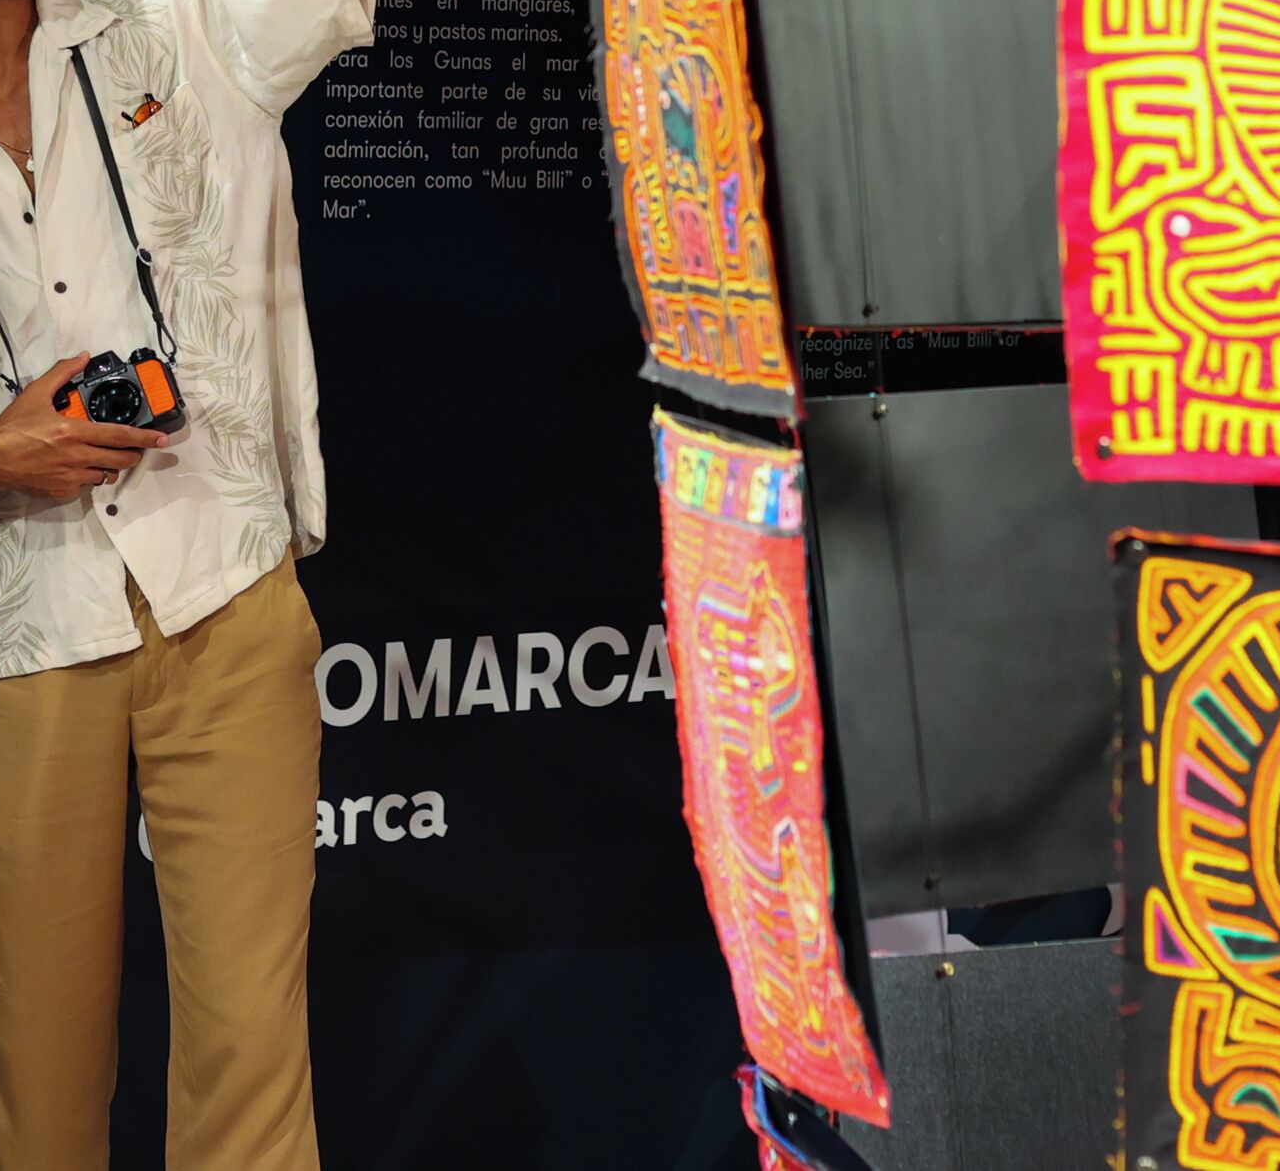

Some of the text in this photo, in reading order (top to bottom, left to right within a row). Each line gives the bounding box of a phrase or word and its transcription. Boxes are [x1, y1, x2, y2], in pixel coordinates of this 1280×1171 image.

[373, 23, 564, 43] inos y pastos marinos.
[389, 49, 414, 69] los
[433, 50, 493, 71] Gunas
[511, 52, 527, 70] el
[546, 58, 580, 72] mar
[325, 79, 424, 103] importante
[440, 84, 489, 104] parte
[504, 81, 527, 101] de
[542, 88, 562, 101] su
[324, 109, 604, 135] conexión familiar de gran res
[324, 139, 430, 162] admiración,
[451, 143, 480, 159] tan
[500, 141, 579, 164] profunda
[323, 173, 416, 190] reconocen
[424, 174, 473, 190] como
[482, 169, 527, 190] “Muu
[536, 170, 573, 190] Billi”
[581, 177, 593, 189] o
[800, 334, 873, 357] recognize
[880, 333, 890, 350] it
[896, 336, 915, 350] as
[1005, 334, 1021, 348] or
[800, 361, 829, 381] ther
[320, 623, 677, 730] OMARCA
[315, 789, 448, 849] arca
